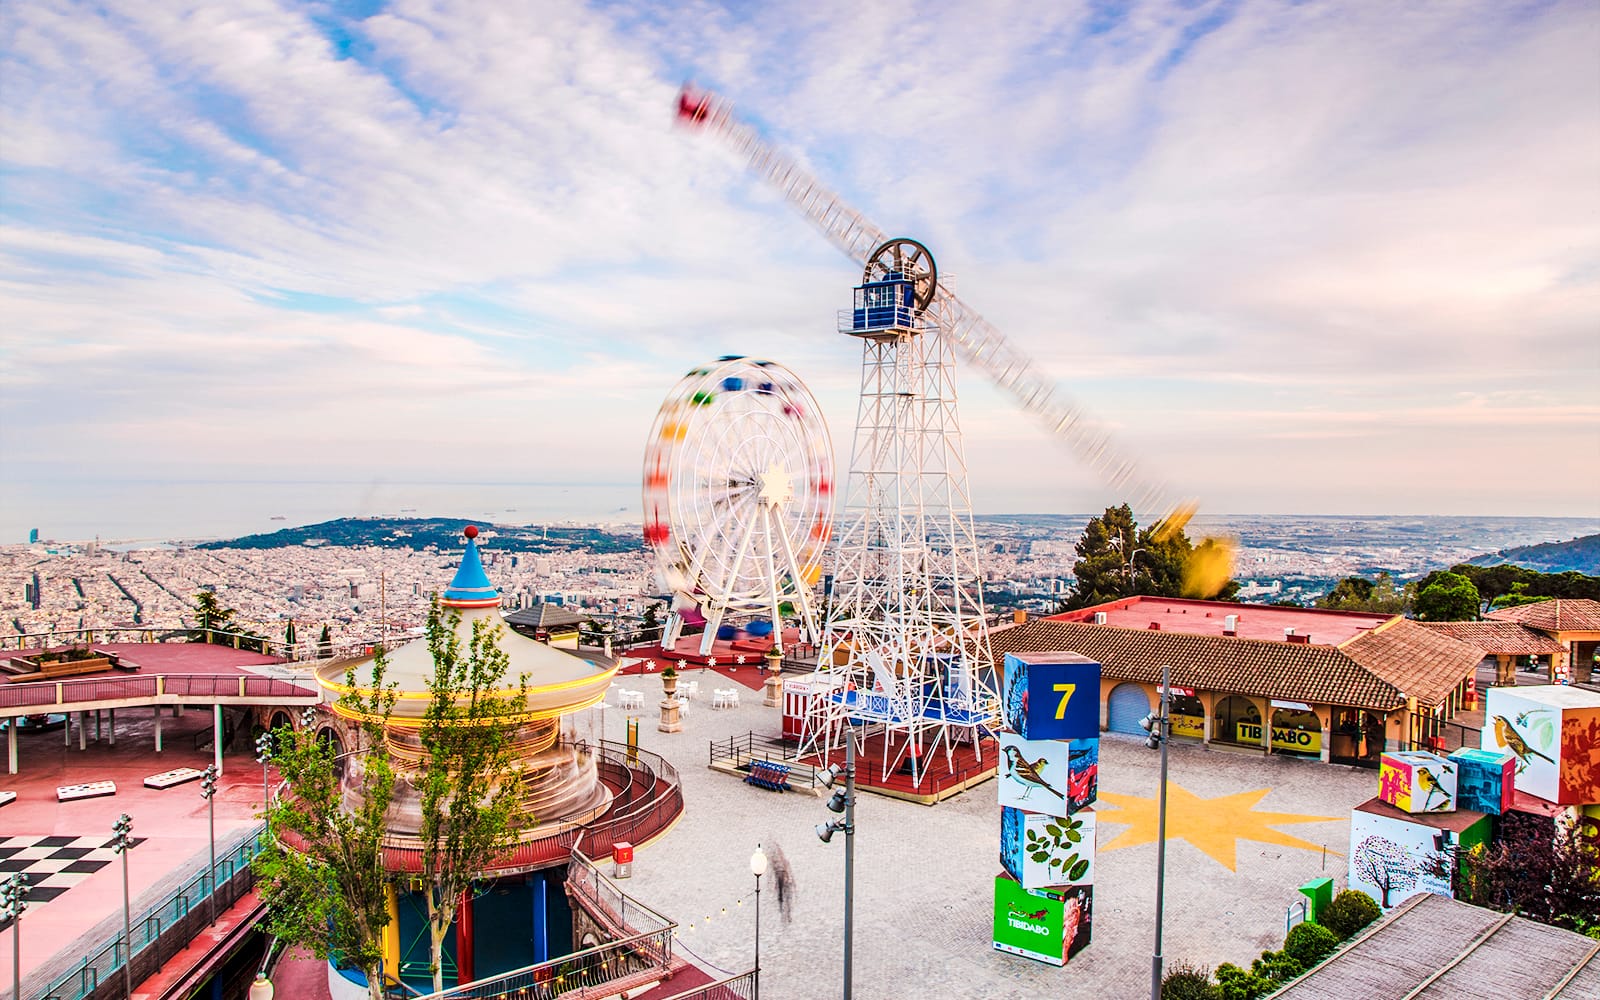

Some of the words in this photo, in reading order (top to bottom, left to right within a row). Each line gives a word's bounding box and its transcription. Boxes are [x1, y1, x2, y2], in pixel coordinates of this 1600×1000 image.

[1053, 683, 1076, 720] 7
[1239, 724, 1312, 746] TIBDABO
[1007, 917, 1050, 937] TIBIDABO
